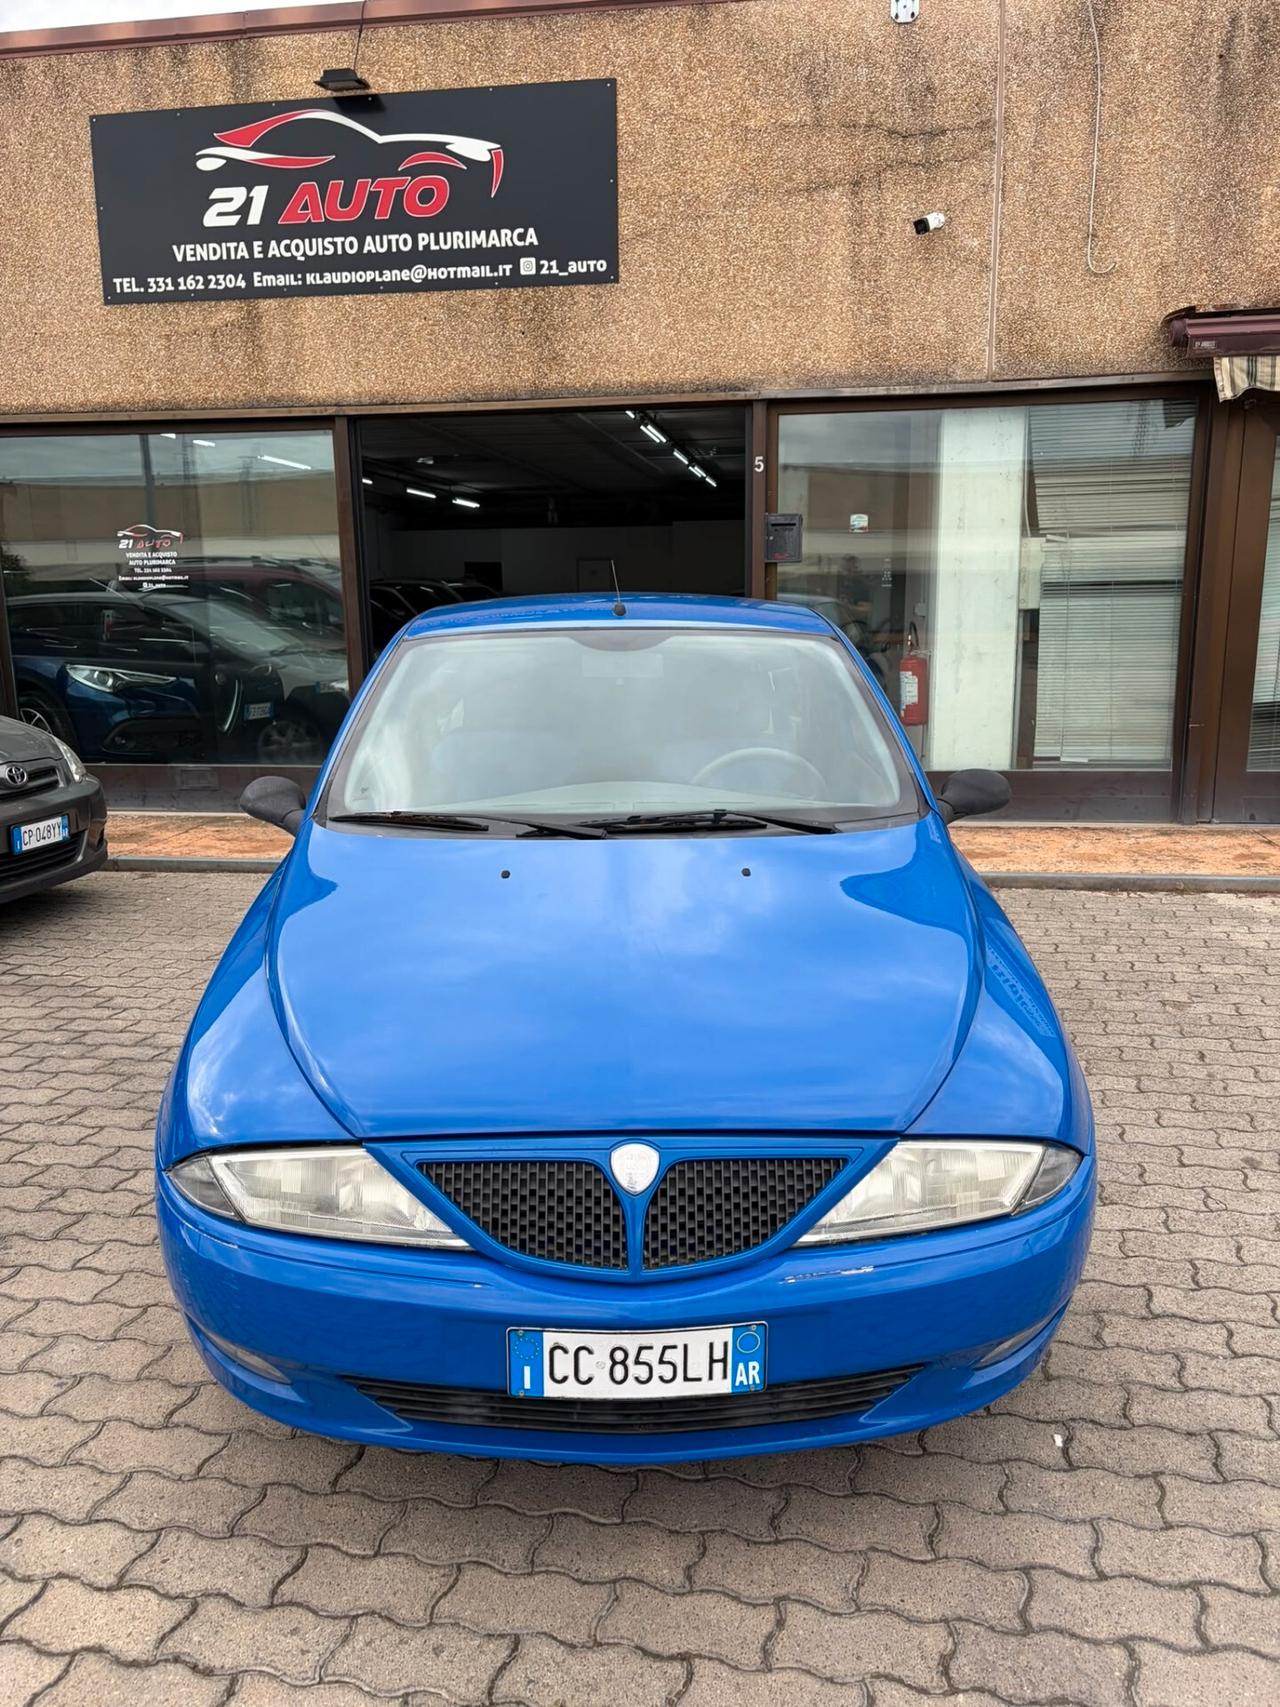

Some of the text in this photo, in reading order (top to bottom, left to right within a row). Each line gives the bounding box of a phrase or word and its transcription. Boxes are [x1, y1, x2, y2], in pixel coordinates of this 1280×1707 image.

[203, 175, 450, 227] 21 AUTO
[172, 227, 539, 262] VENDITA E ACQUISTO AUTO PLURIMARCA
[113, 277, 144, 293] TEL.
[147, 276, 174, 292] 331
[177, 274, 203, 290] 162
[207, 273, 246, 289] 2304
[754, 456, 765, 472] 5
[119, 539, 171, 549] 21 AUTO
[549, 1344, 595, 1386] CC
[735, 1361, 761, 1387] AR
